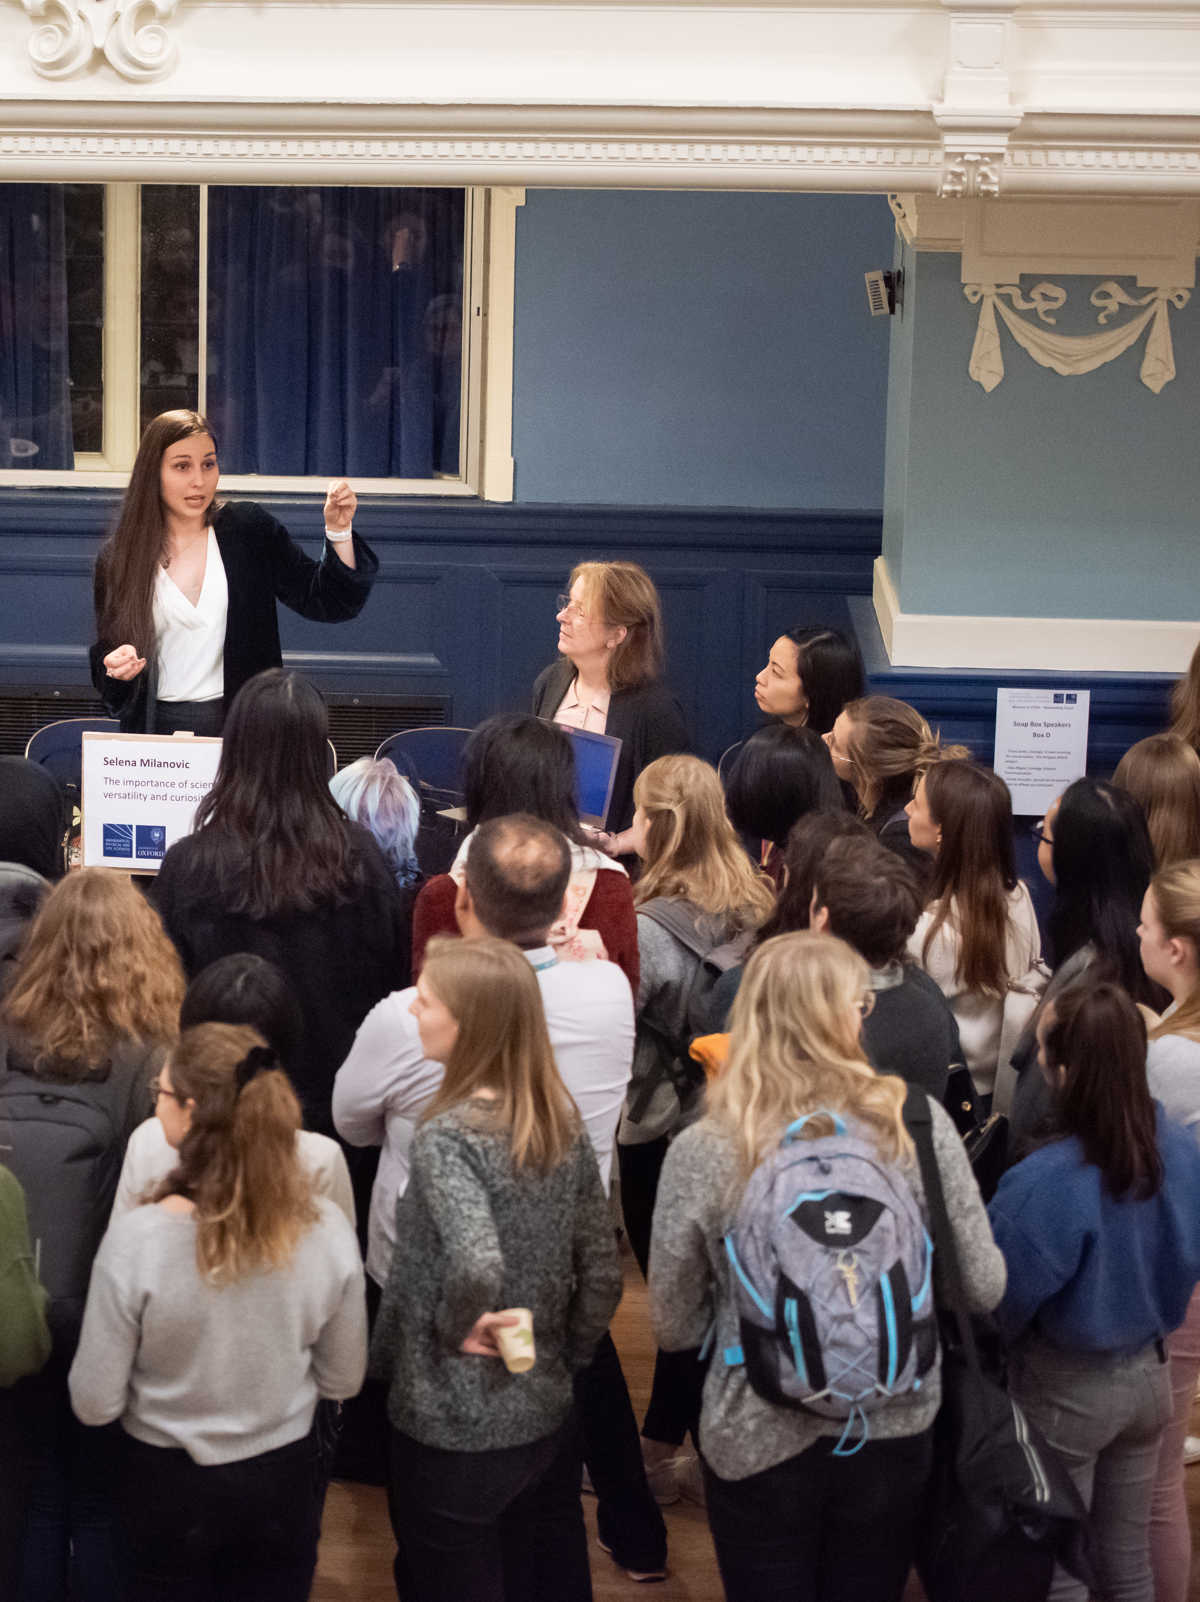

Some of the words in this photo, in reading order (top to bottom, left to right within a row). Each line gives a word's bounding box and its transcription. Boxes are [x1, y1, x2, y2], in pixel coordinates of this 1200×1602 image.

[103, 756, 137, 767] Selena
[140, 758, 190, 769] Milanovic
[104, 776, 121, 786] The
[123, 778, 176, 789] importance
[178, 780, 188, 789] of
[190, 781, 214, 789] scien
[103, 791, 147, 802] versatility
[150, 792, 167, 801] and
[170, 793, 205, 802] curiosit
[137, 849, 164, 857] OXFORD
